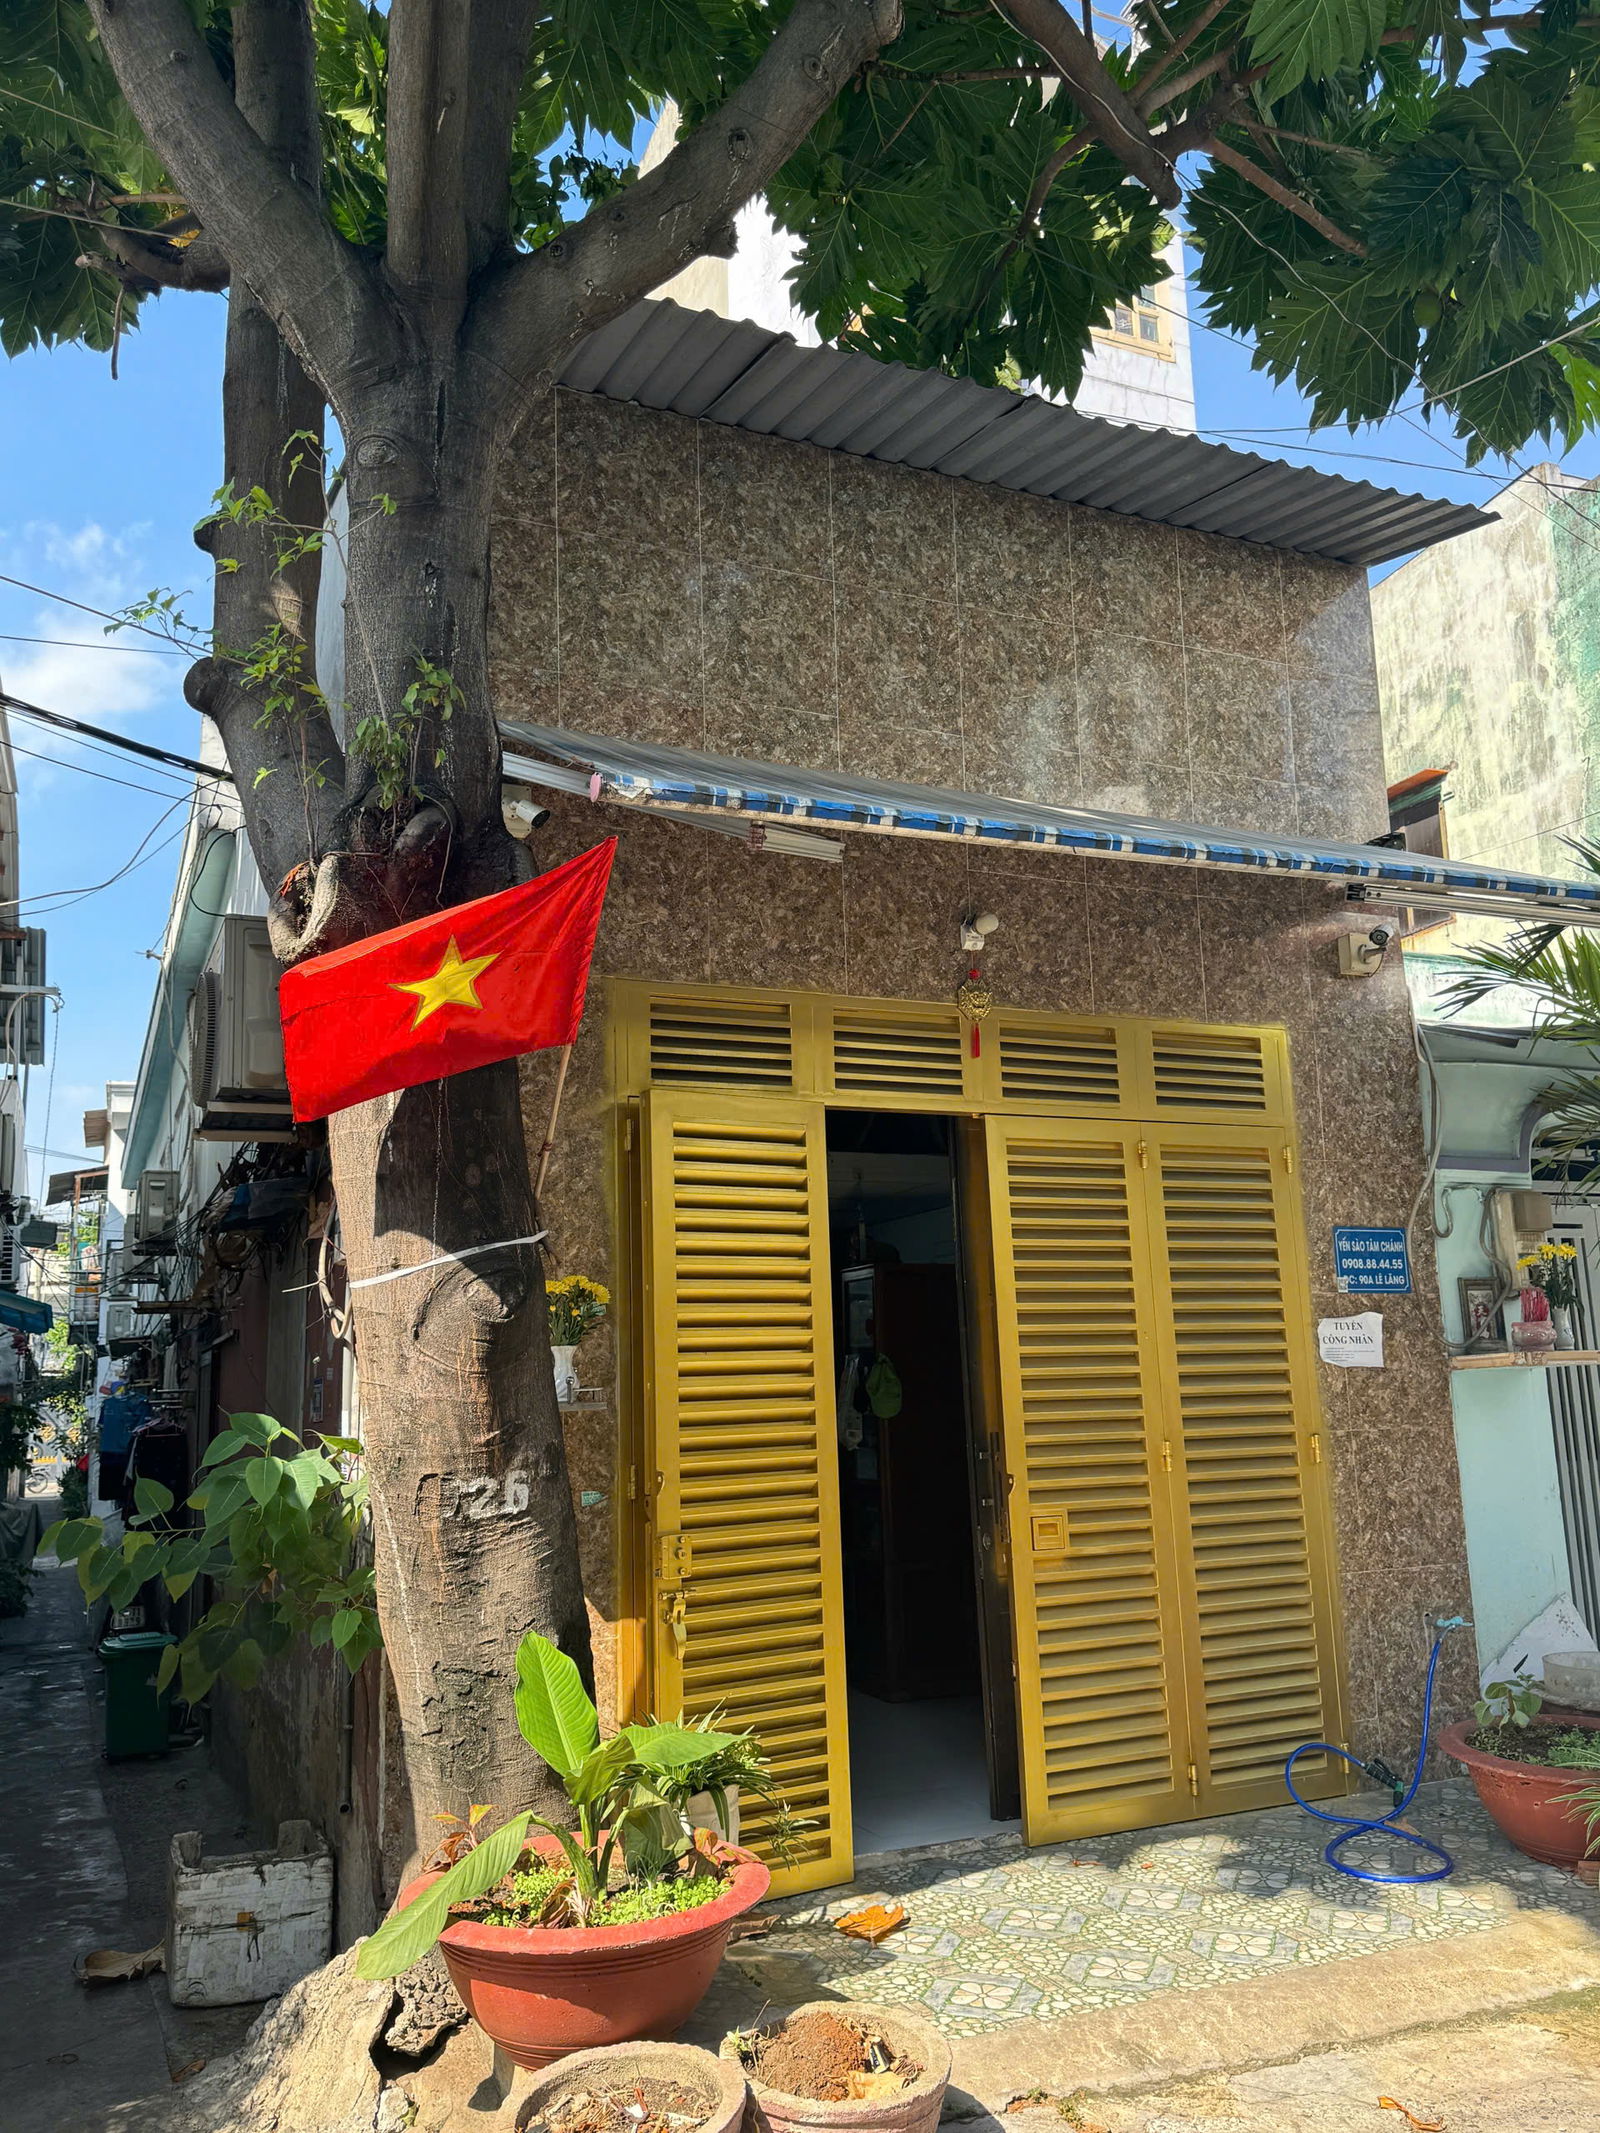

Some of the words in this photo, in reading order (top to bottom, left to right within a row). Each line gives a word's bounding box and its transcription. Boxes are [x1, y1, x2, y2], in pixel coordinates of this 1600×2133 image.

[1352, 1238, 1365, 1252] SÀO
[1342, 1258, 1403, 1269] 0908.88.44.55
[1359, 1275, 1374, 1284] 90A
[1322, 1333, 1347, 1344] CÔNG
[1349, 1333, 1374, 1344] NHÂN
